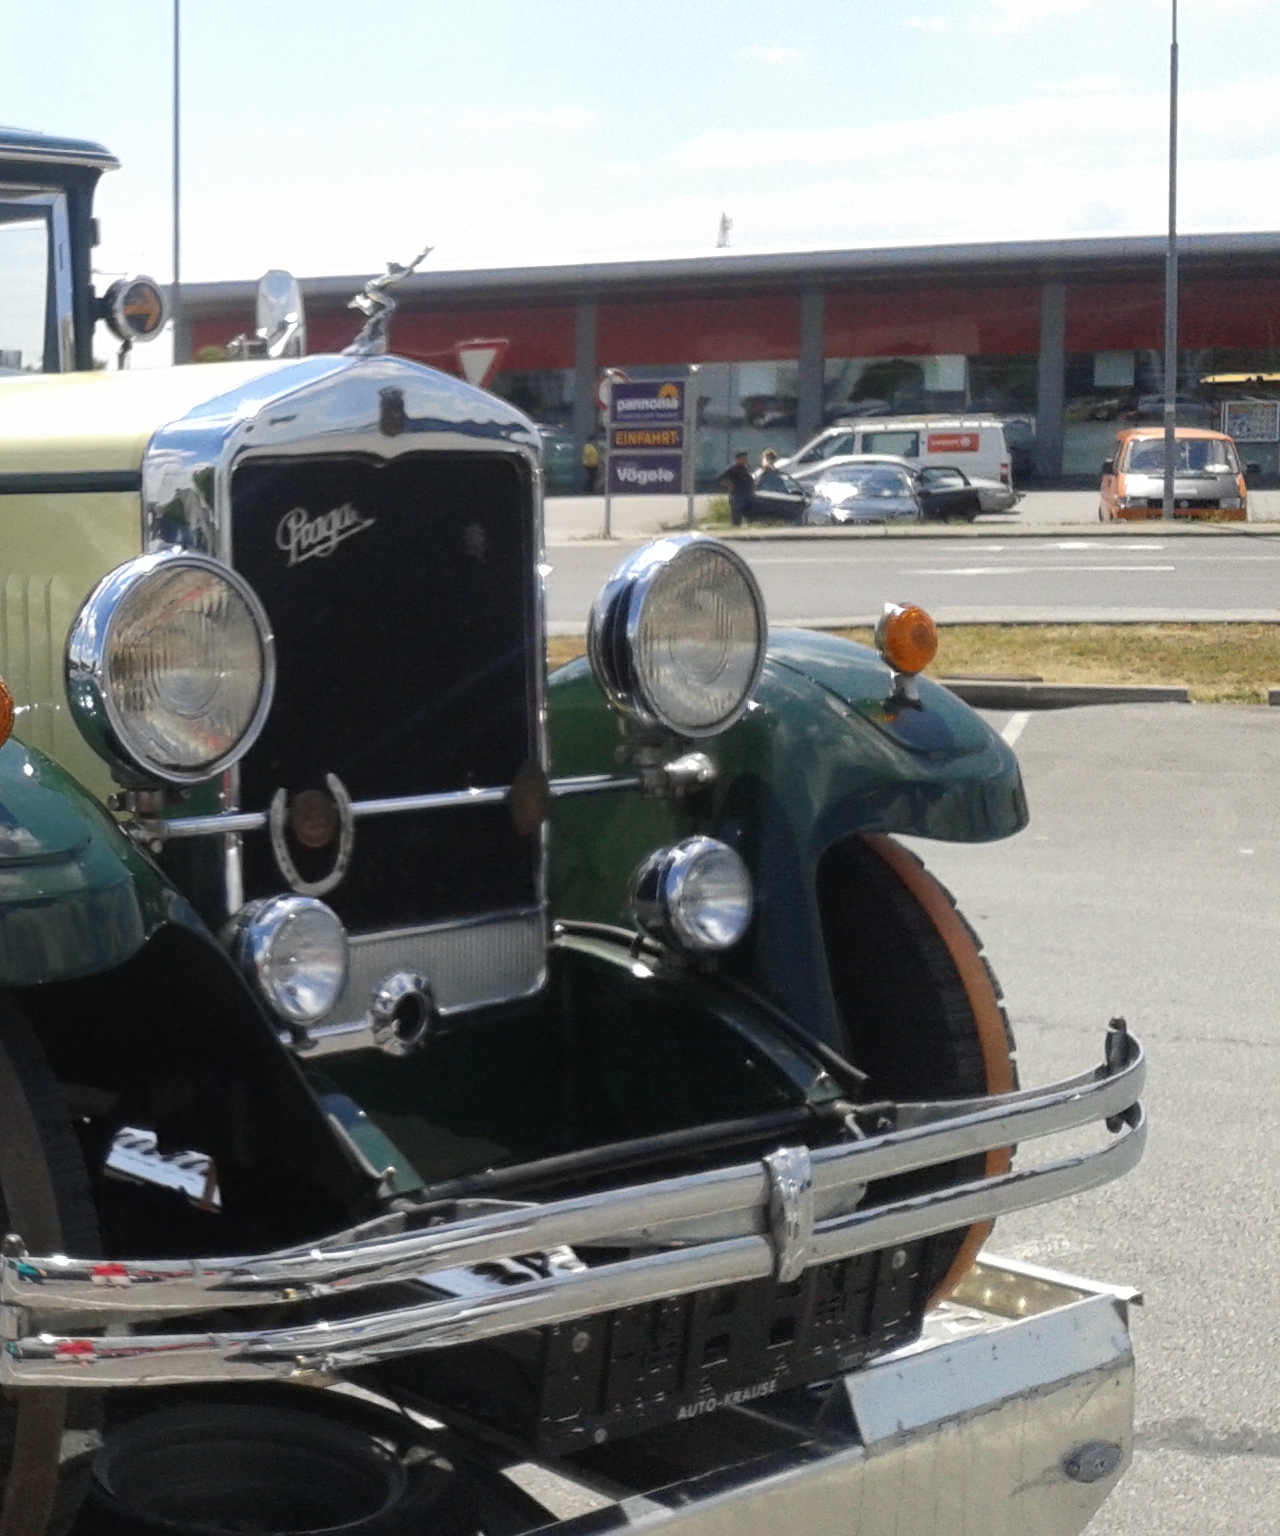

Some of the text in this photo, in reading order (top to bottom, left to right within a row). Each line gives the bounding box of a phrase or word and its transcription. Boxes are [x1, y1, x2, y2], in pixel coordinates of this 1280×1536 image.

[615, 430, 678, 446] EINFAHRT
[617, 467, 675, 485] Vögele
[677, 1379, 777, 1420] AUTO-KRAUSE
